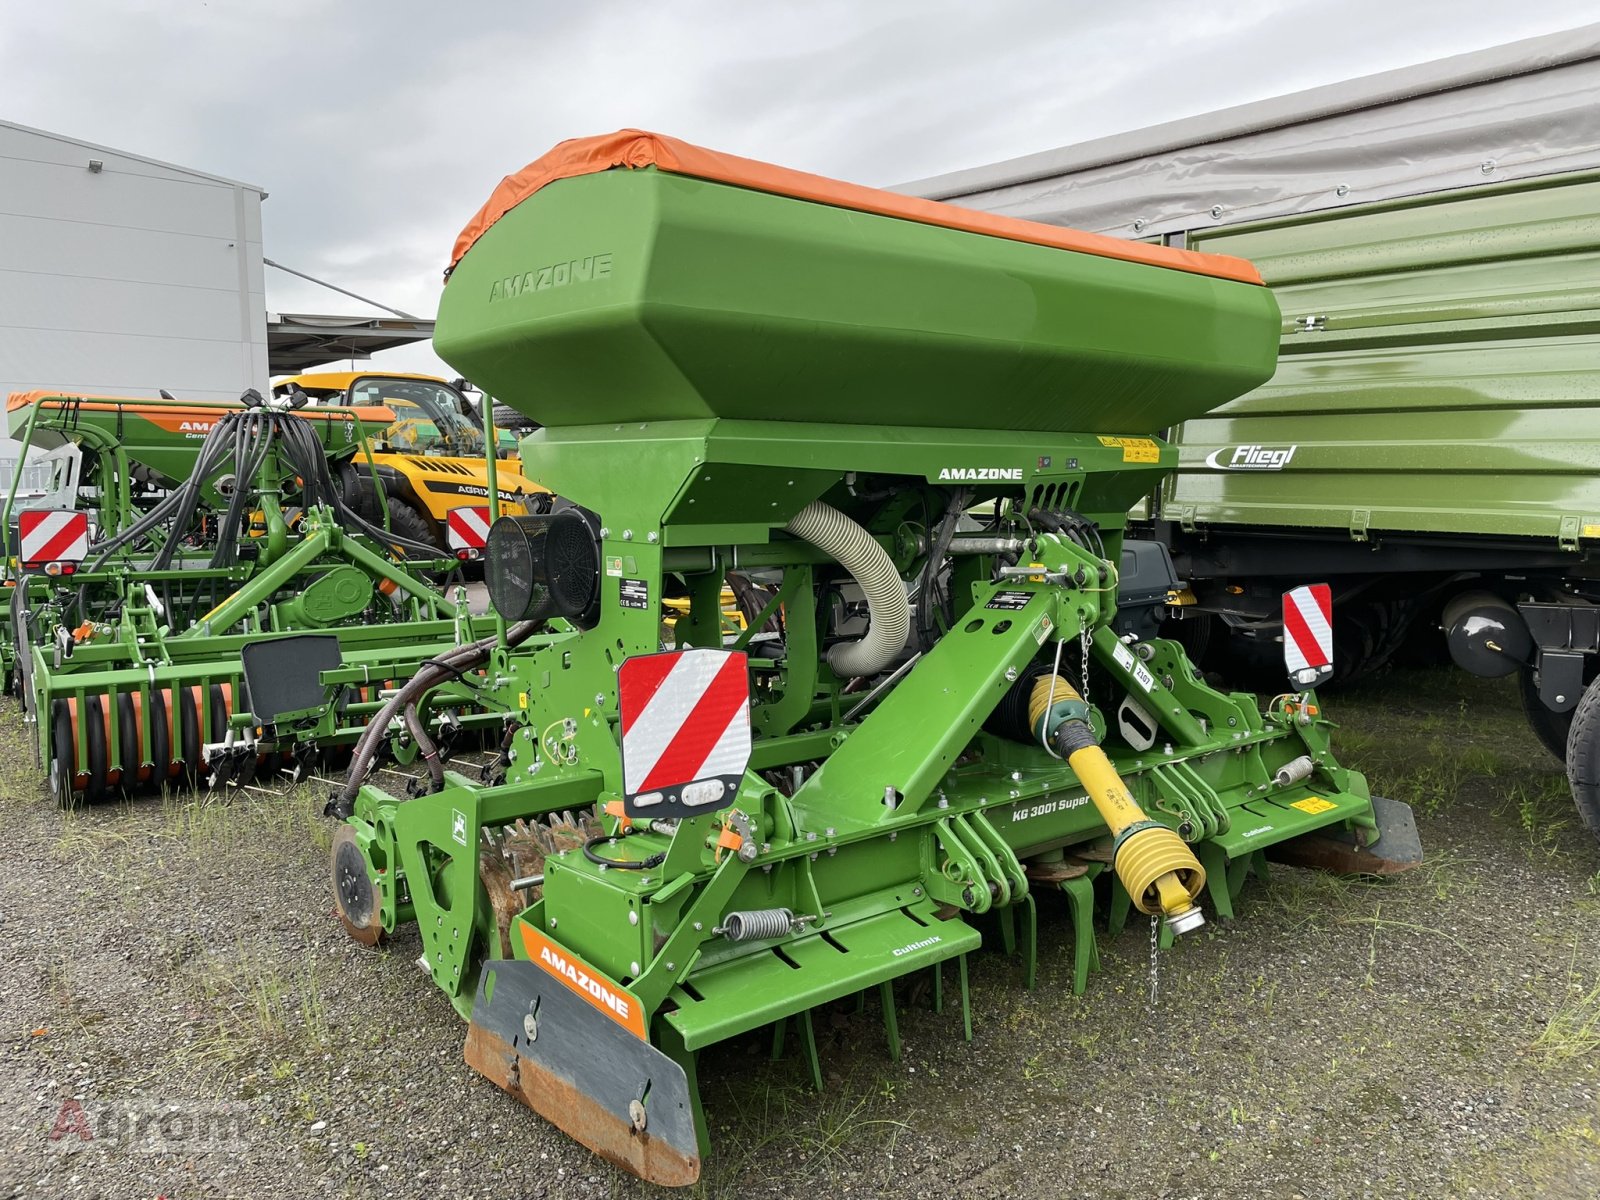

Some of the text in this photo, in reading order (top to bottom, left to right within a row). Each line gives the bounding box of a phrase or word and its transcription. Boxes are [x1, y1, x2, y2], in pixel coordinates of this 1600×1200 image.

[488, 253, 612, 303] AMAZONE
[1230, 445, 1297, 469] Fliegl
[938, 468, 1022, 480] AMAZONE
[458, 486, 513, 500] AGRIXRA
[1136, 668, 1151, 685] 2107
[1012, 809, 1028, 821] KG
[1031, 802, 1056, 817] 3001
[1058, 796, 1090, 810] Super
[892, 936, 942, 957] Cultimix
[541, 946, 628, 1019] AMAZONE
